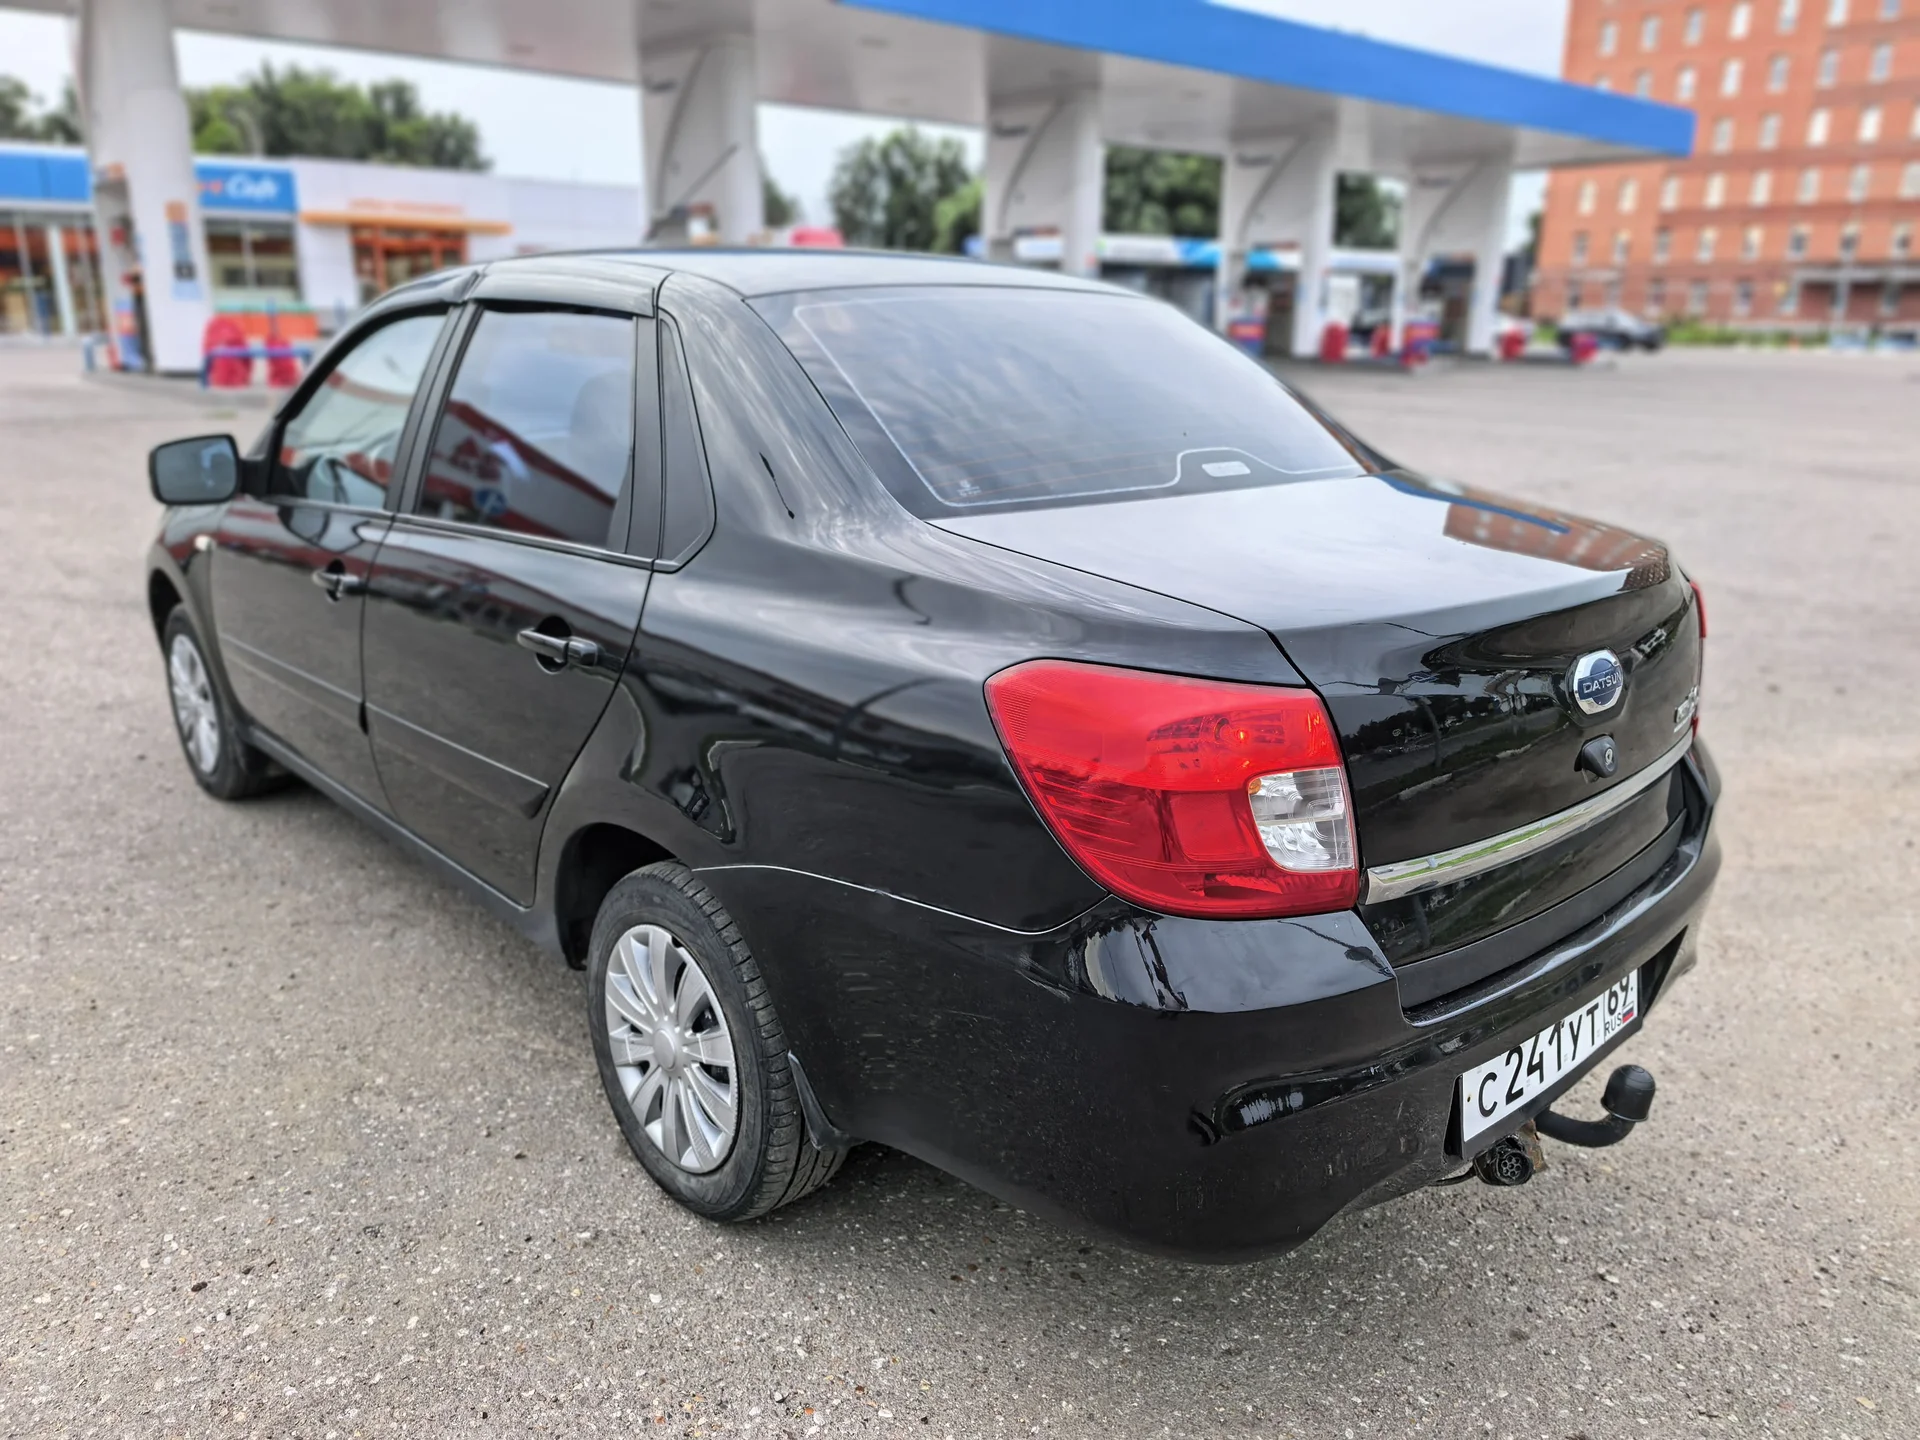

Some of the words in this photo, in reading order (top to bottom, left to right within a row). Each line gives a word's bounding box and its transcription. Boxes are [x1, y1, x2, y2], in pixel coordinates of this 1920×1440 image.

[1583, 671, 1622, 694] DATSUN
[1607, 974, 1630, 1016] 69
[1604, 1012, 1622, 1035] RUS
